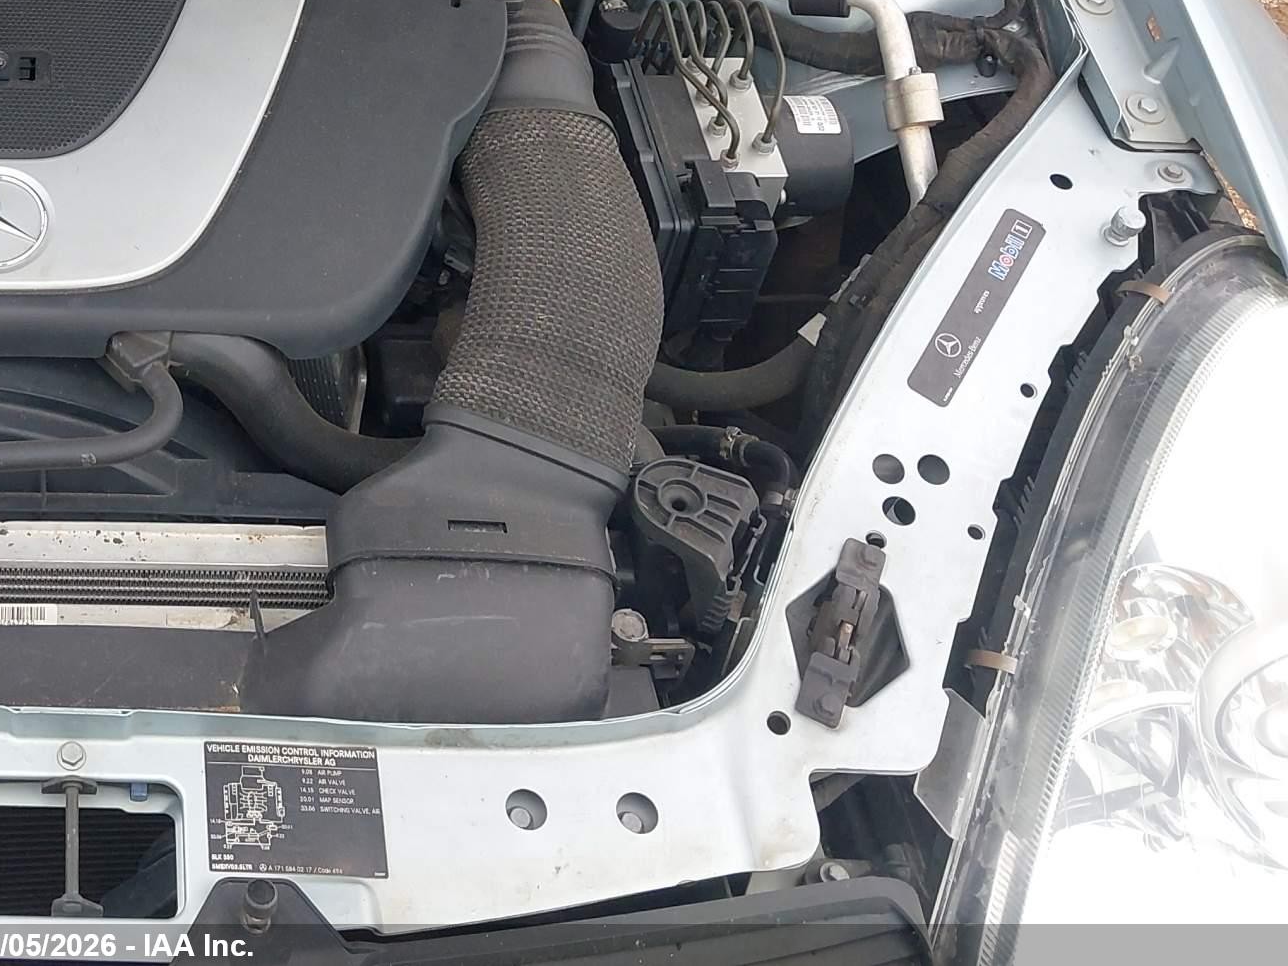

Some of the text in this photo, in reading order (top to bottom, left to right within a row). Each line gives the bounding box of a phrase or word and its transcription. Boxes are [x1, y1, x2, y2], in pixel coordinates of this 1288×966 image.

[988, 233, 1025, 281] Mobil
[207, 744, 375, 759] VEHICLE EMISSION CONTROL INFORMATION
[248, 754, 336, 766] DAIMLERCHRYSLER AG
